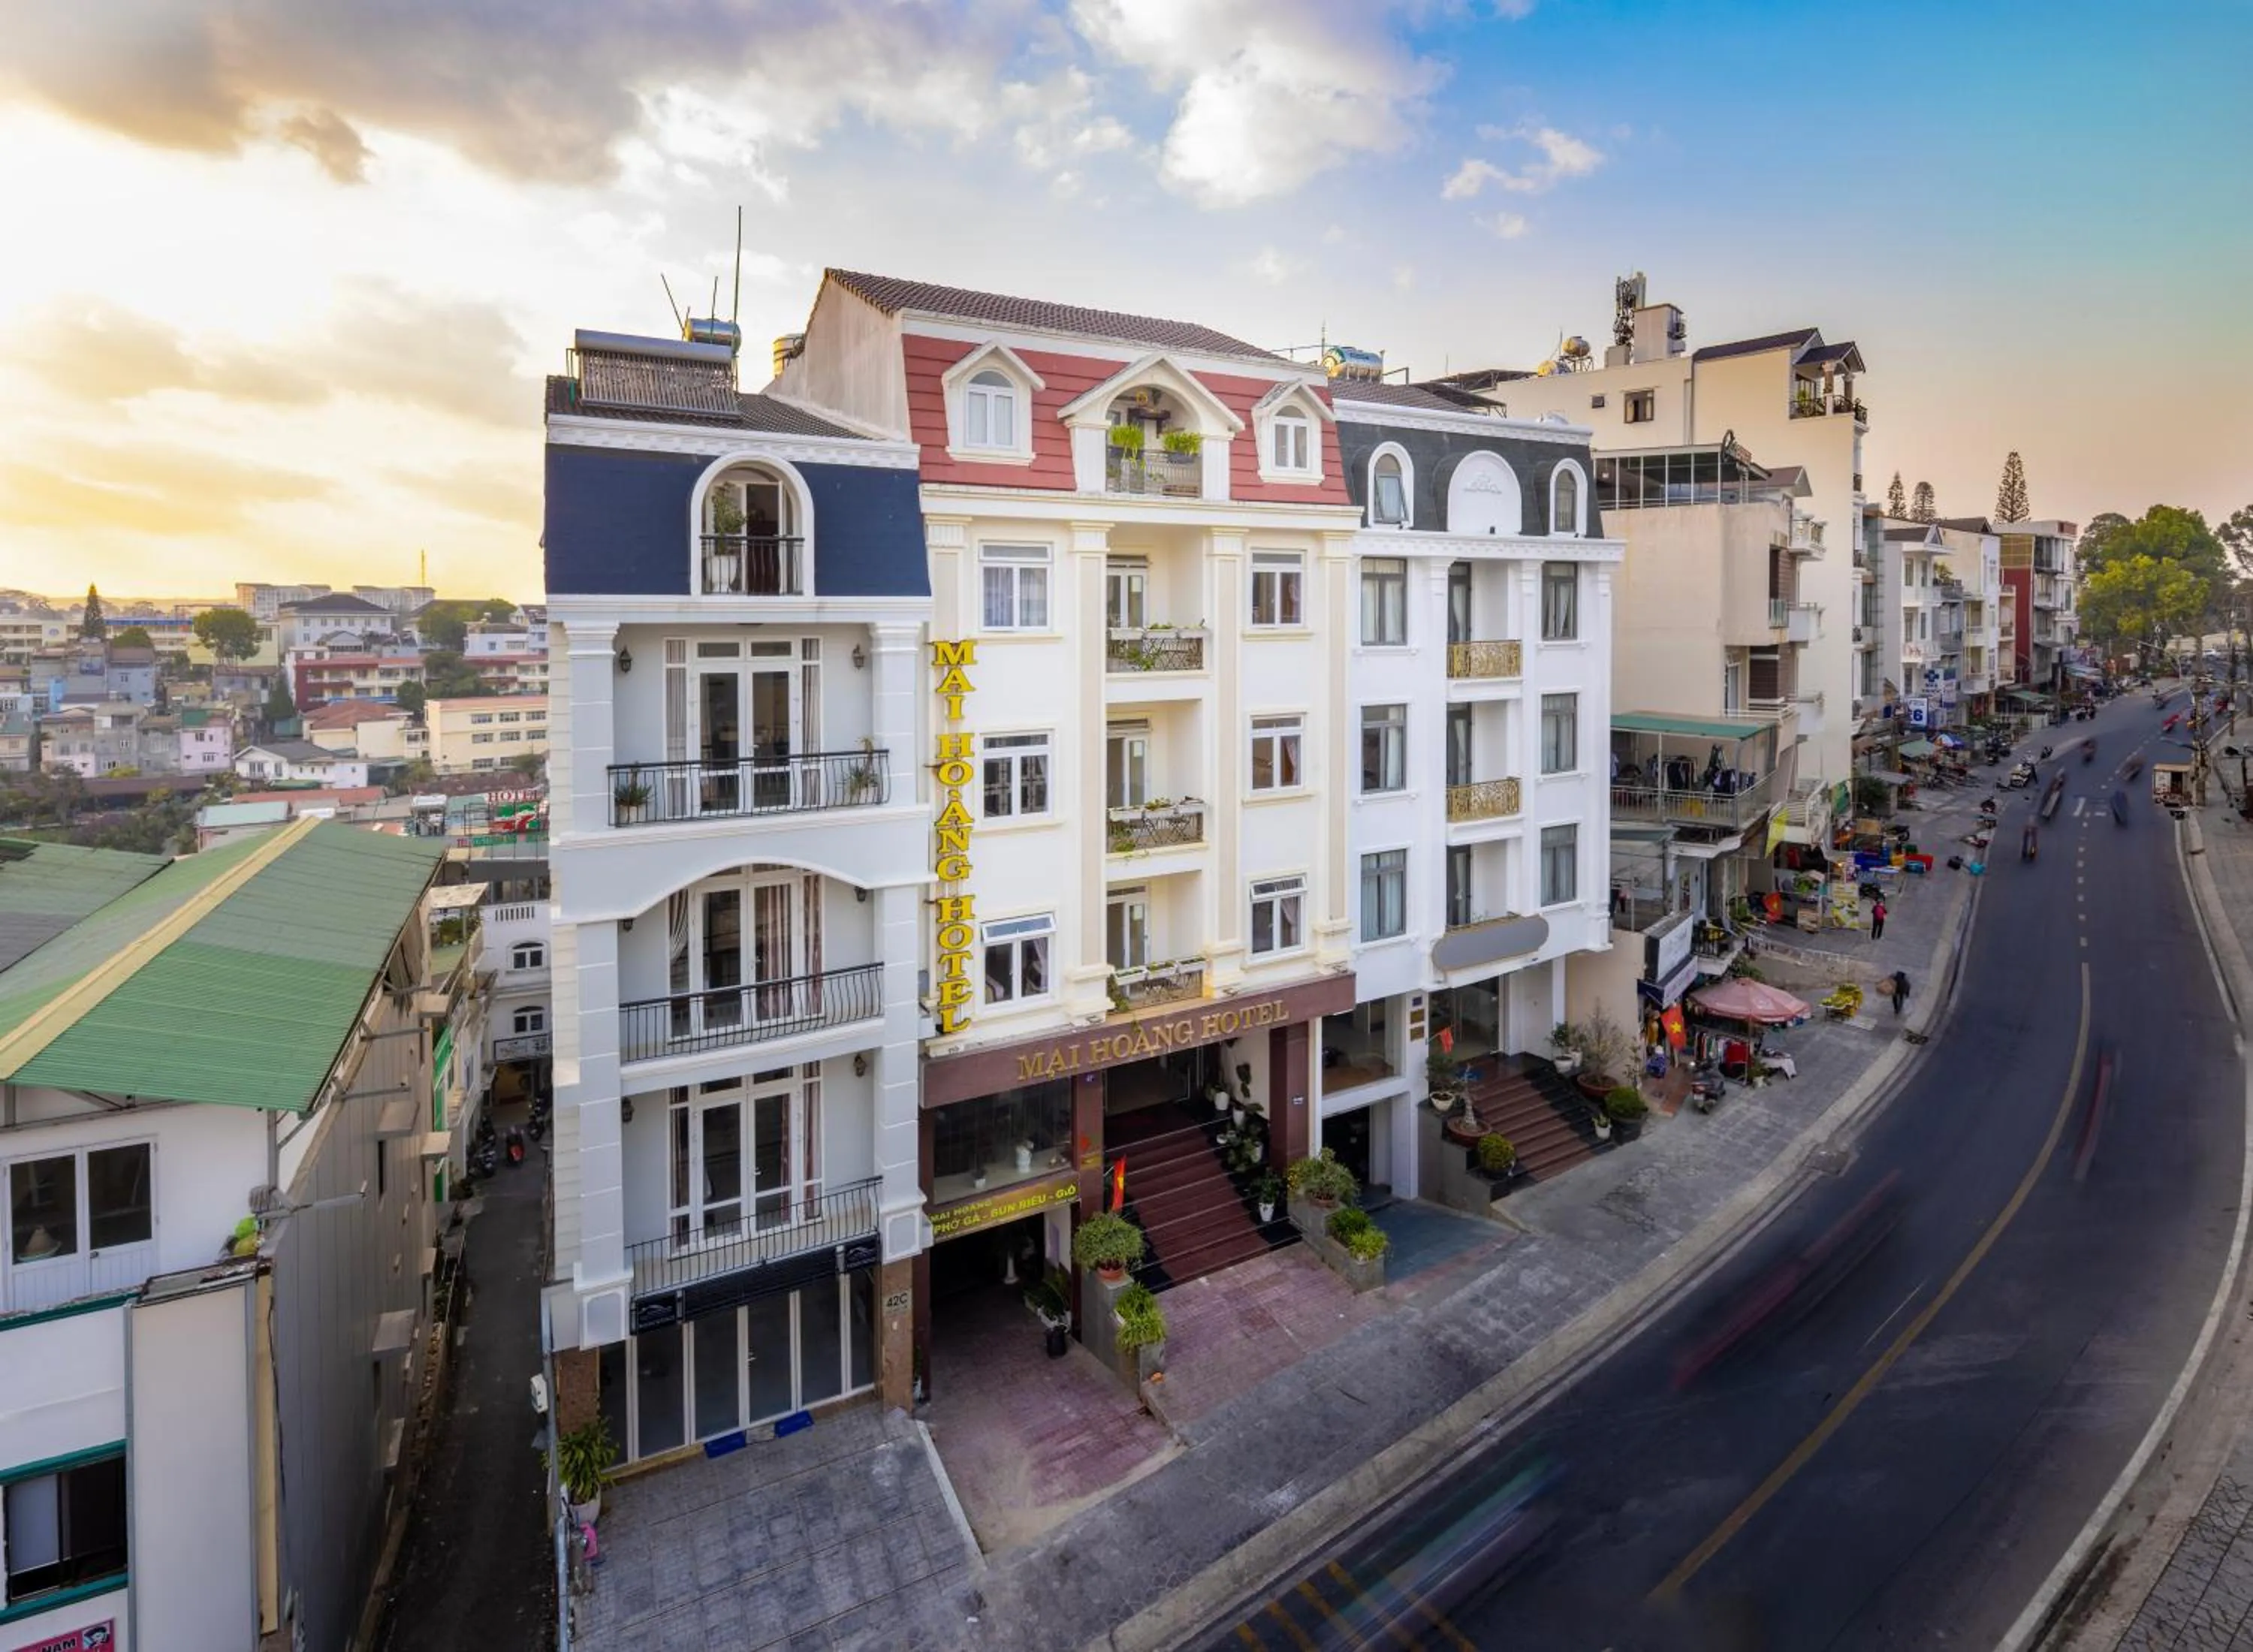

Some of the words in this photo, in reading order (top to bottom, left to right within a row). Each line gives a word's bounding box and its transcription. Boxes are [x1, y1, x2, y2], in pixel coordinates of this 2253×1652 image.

[931, 641, 978, 720] MAI
[936, 894, 976, 1034] HOTEL
[1201, 999, 1289, 1039] HOTEL
[886, 1292, 908, 1307] 42C
